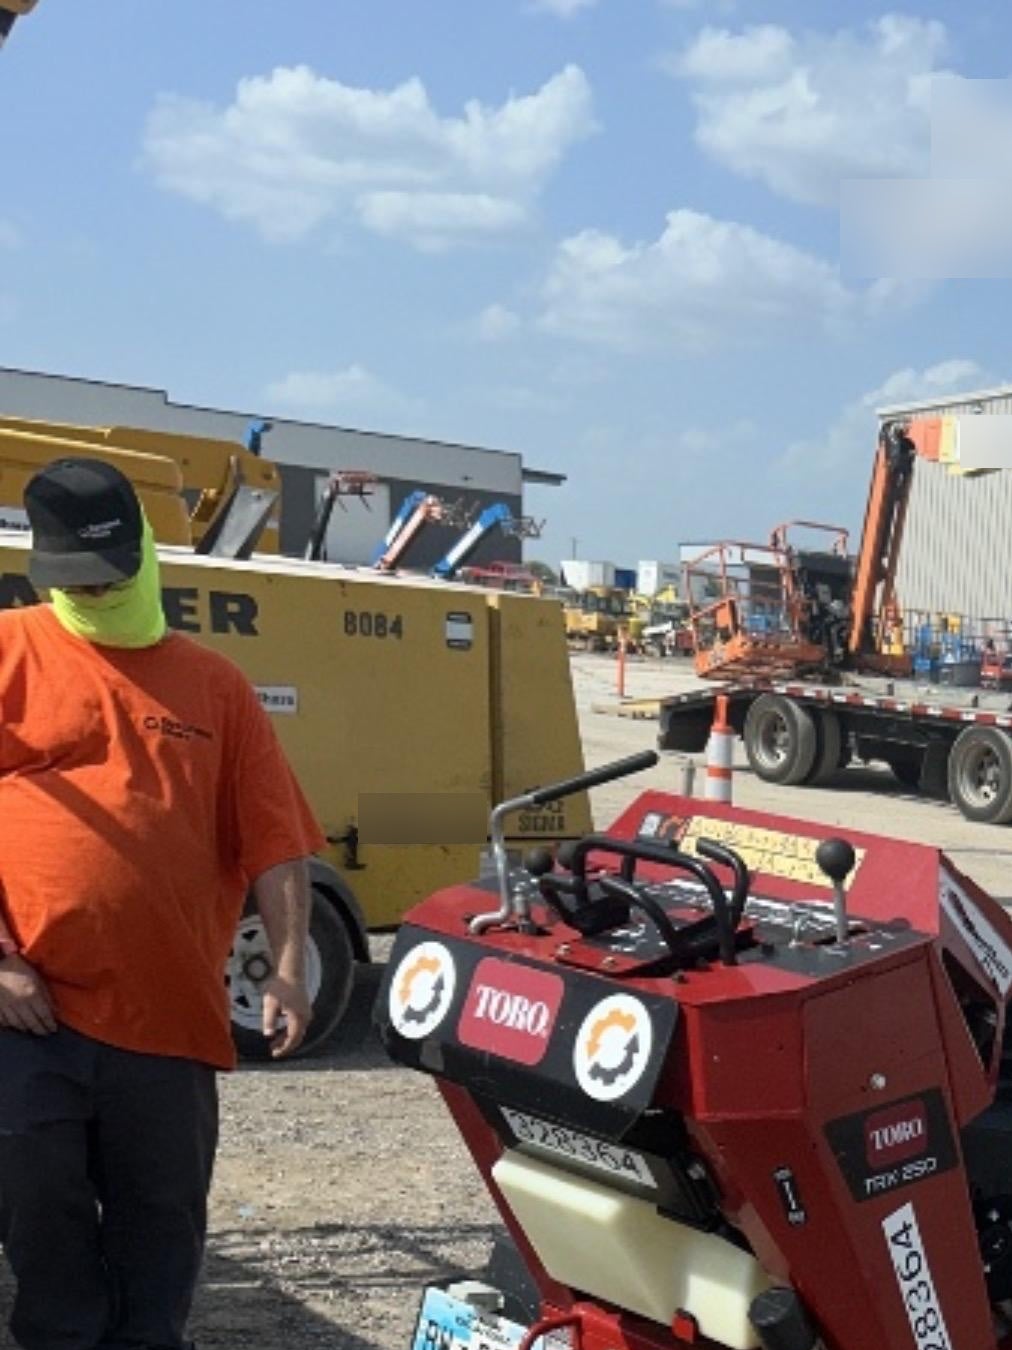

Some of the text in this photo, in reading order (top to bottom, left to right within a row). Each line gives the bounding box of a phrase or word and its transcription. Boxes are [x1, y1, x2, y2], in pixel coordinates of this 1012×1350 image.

[474, 984, 550, 1037] TORO
[869, 1116, 923, 1150] TORO
[901, 1156, 937, 1181] 250
